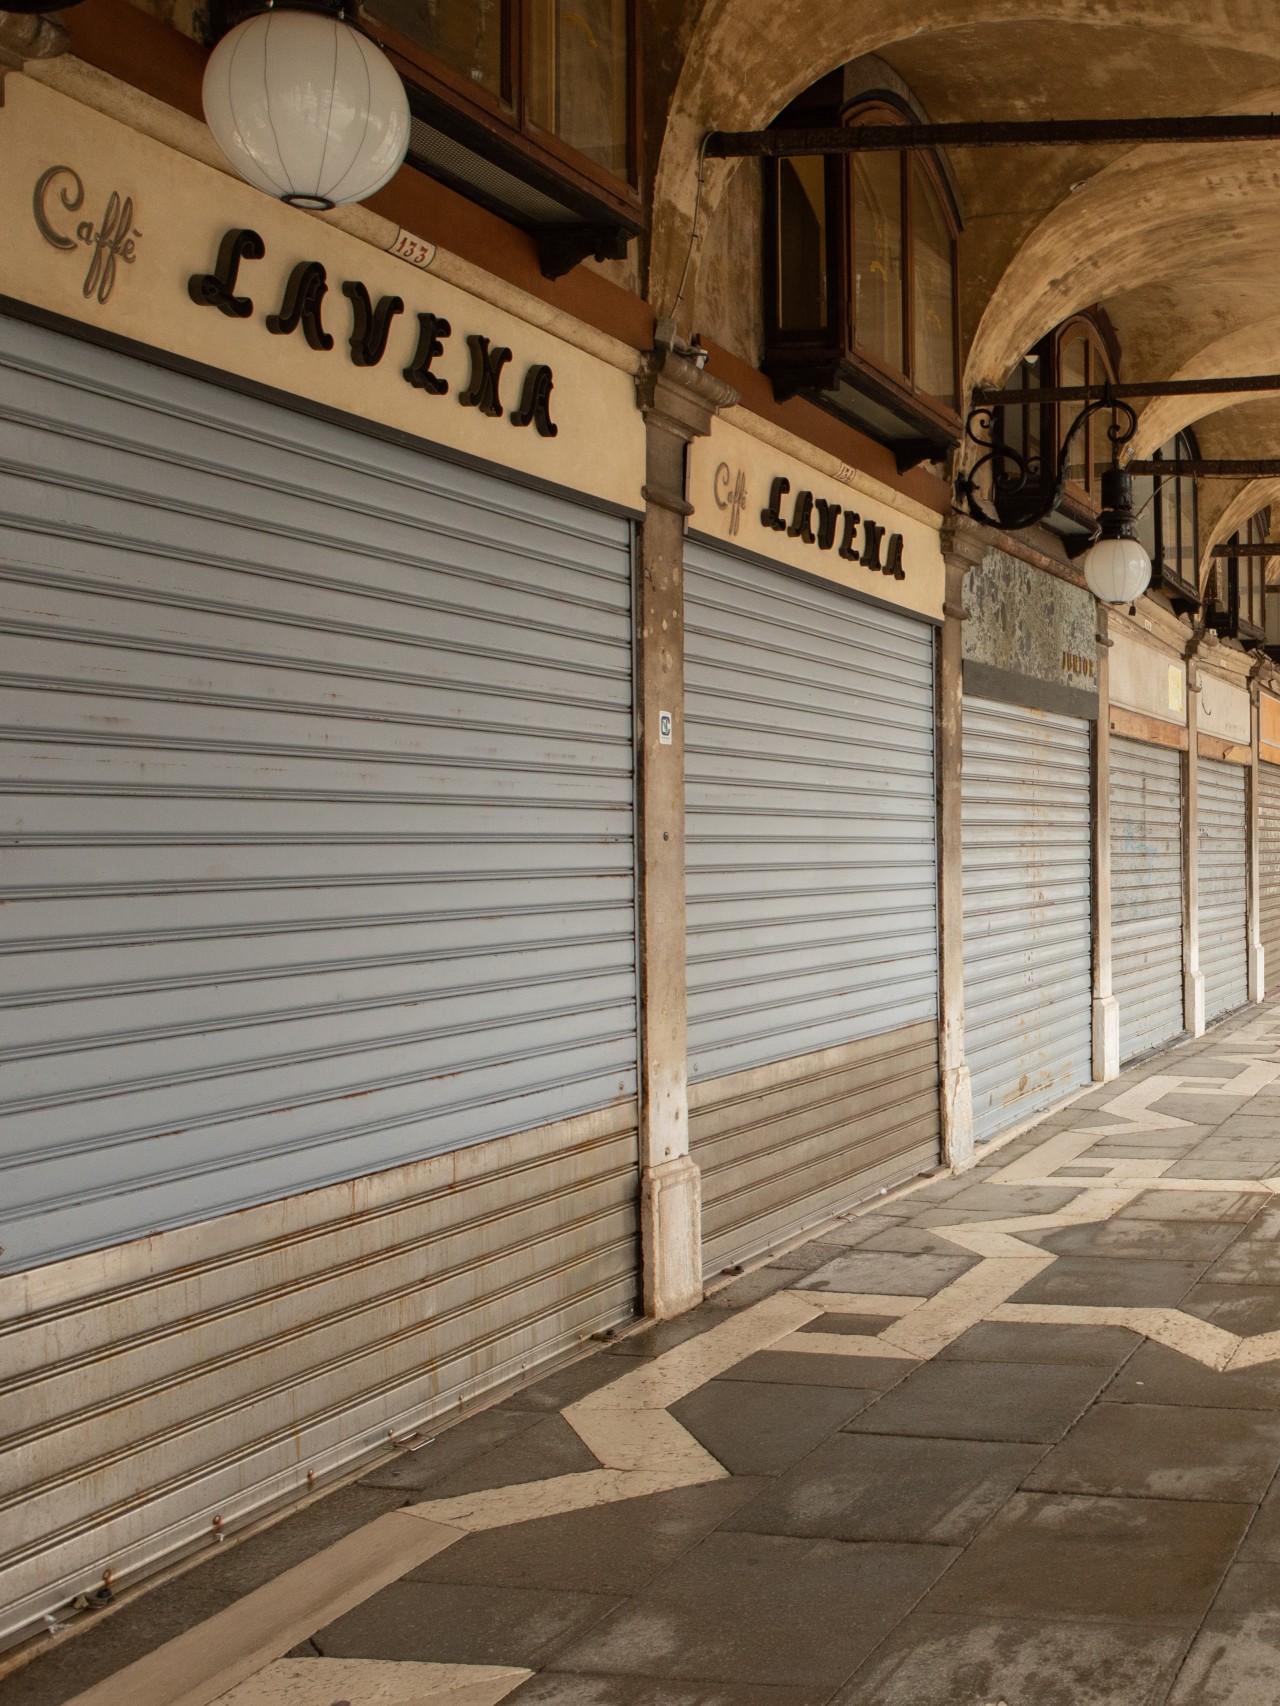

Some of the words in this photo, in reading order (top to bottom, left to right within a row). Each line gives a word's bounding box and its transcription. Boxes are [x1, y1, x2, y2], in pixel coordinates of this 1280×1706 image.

[33, 165, 142, 304] Caffè
[188, 228, 558, 437] LAVENA
[396, 237, 428, 263] 133
[714, 461, 747, 536] Caffè
[761, 477, 905, 580] LAVENA
